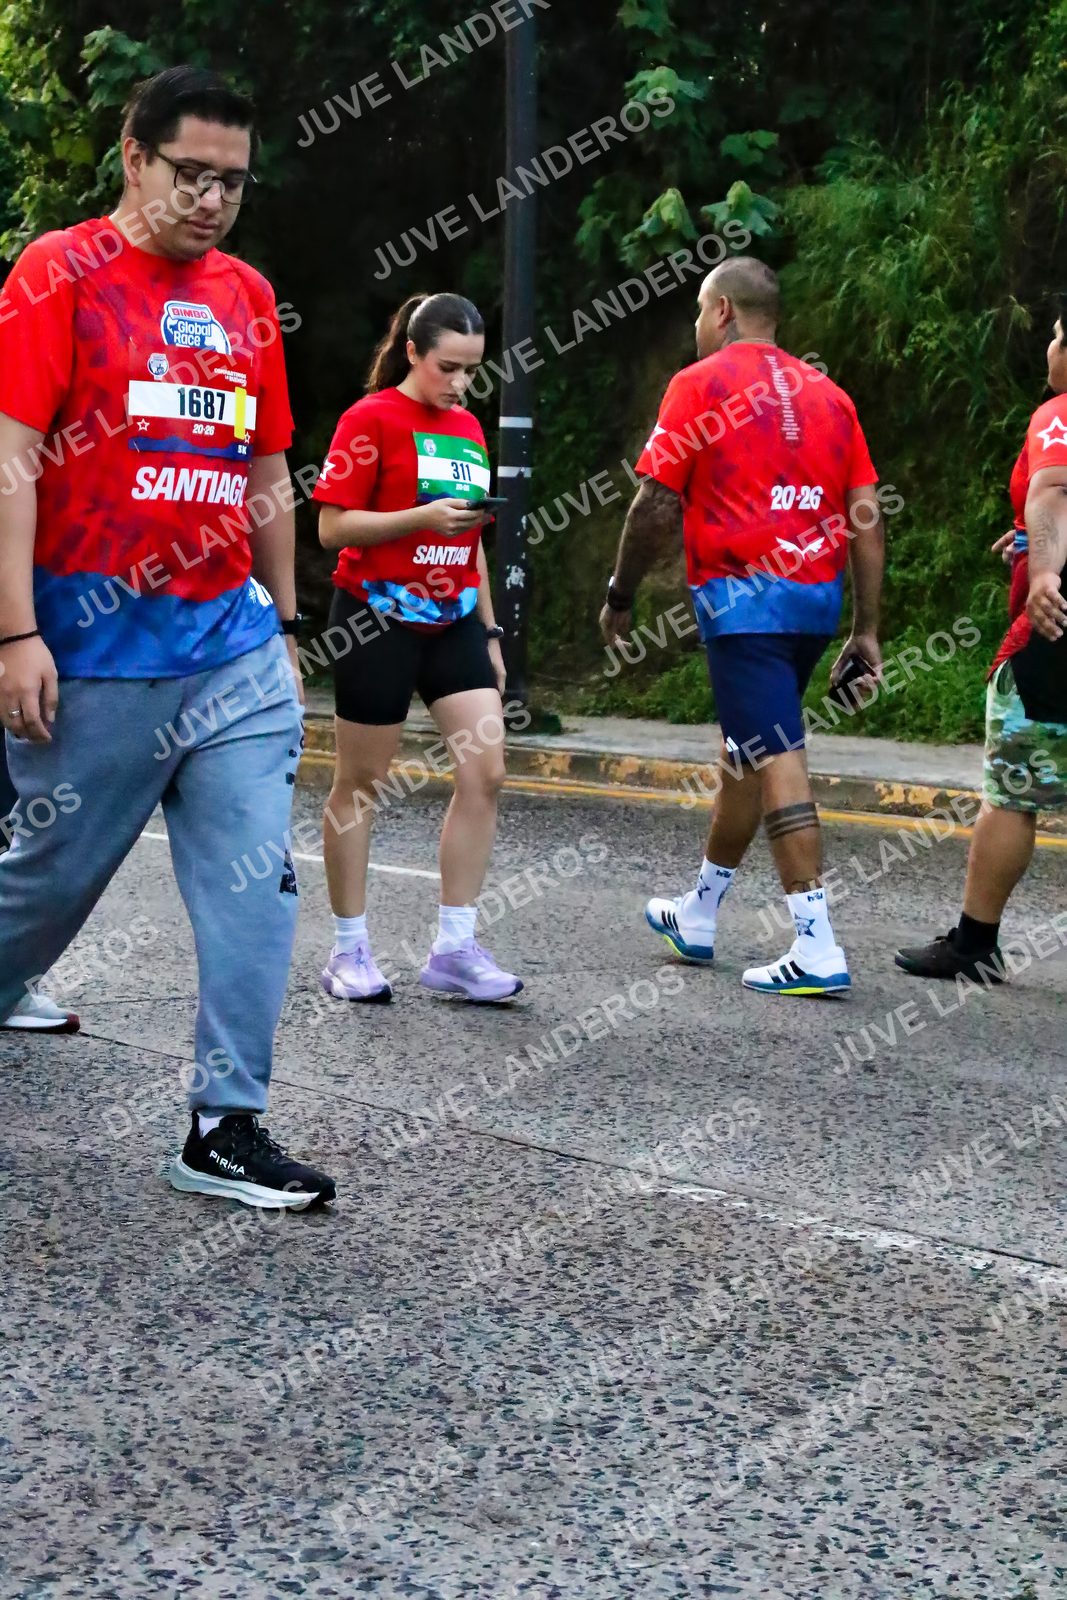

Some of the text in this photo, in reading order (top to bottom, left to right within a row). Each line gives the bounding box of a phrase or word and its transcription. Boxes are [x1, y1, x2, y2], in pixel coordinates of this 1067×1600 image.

[171, 307, 208, 320] BIMBO
[177, 320, 211, 336] Global
[173, 331, 201, 347] Race
[177, 387, 226, 421] 1687
[450, 461, 472, 482] 311
[209, 1149, 245, 1175] PIRMA
